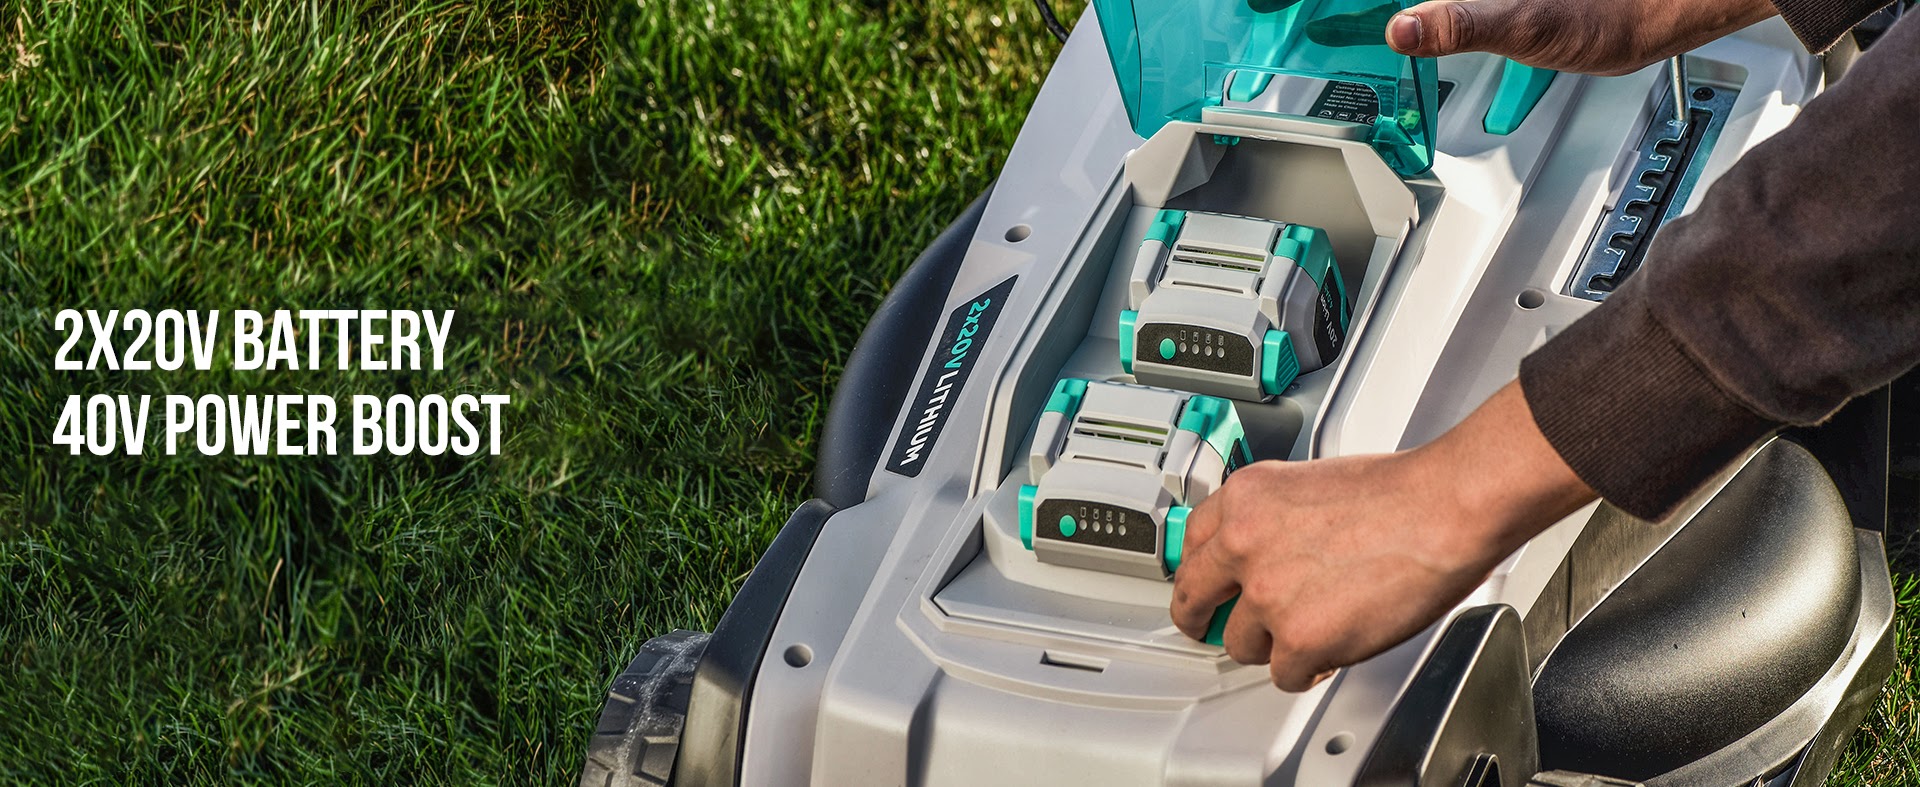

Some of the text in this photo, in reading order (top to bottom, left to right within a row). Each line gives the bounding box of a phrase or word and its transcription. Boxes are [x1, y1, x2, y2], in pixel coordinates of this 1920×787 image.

[1649, 154, 1671, 162] 5
[1635, 184, 1654, 193] 4
[1620, 215, 1640, 223] 3
[1604, 247, 1626, 256] 2
[900, 298, 991, 466] 2x20V LITHIUM
